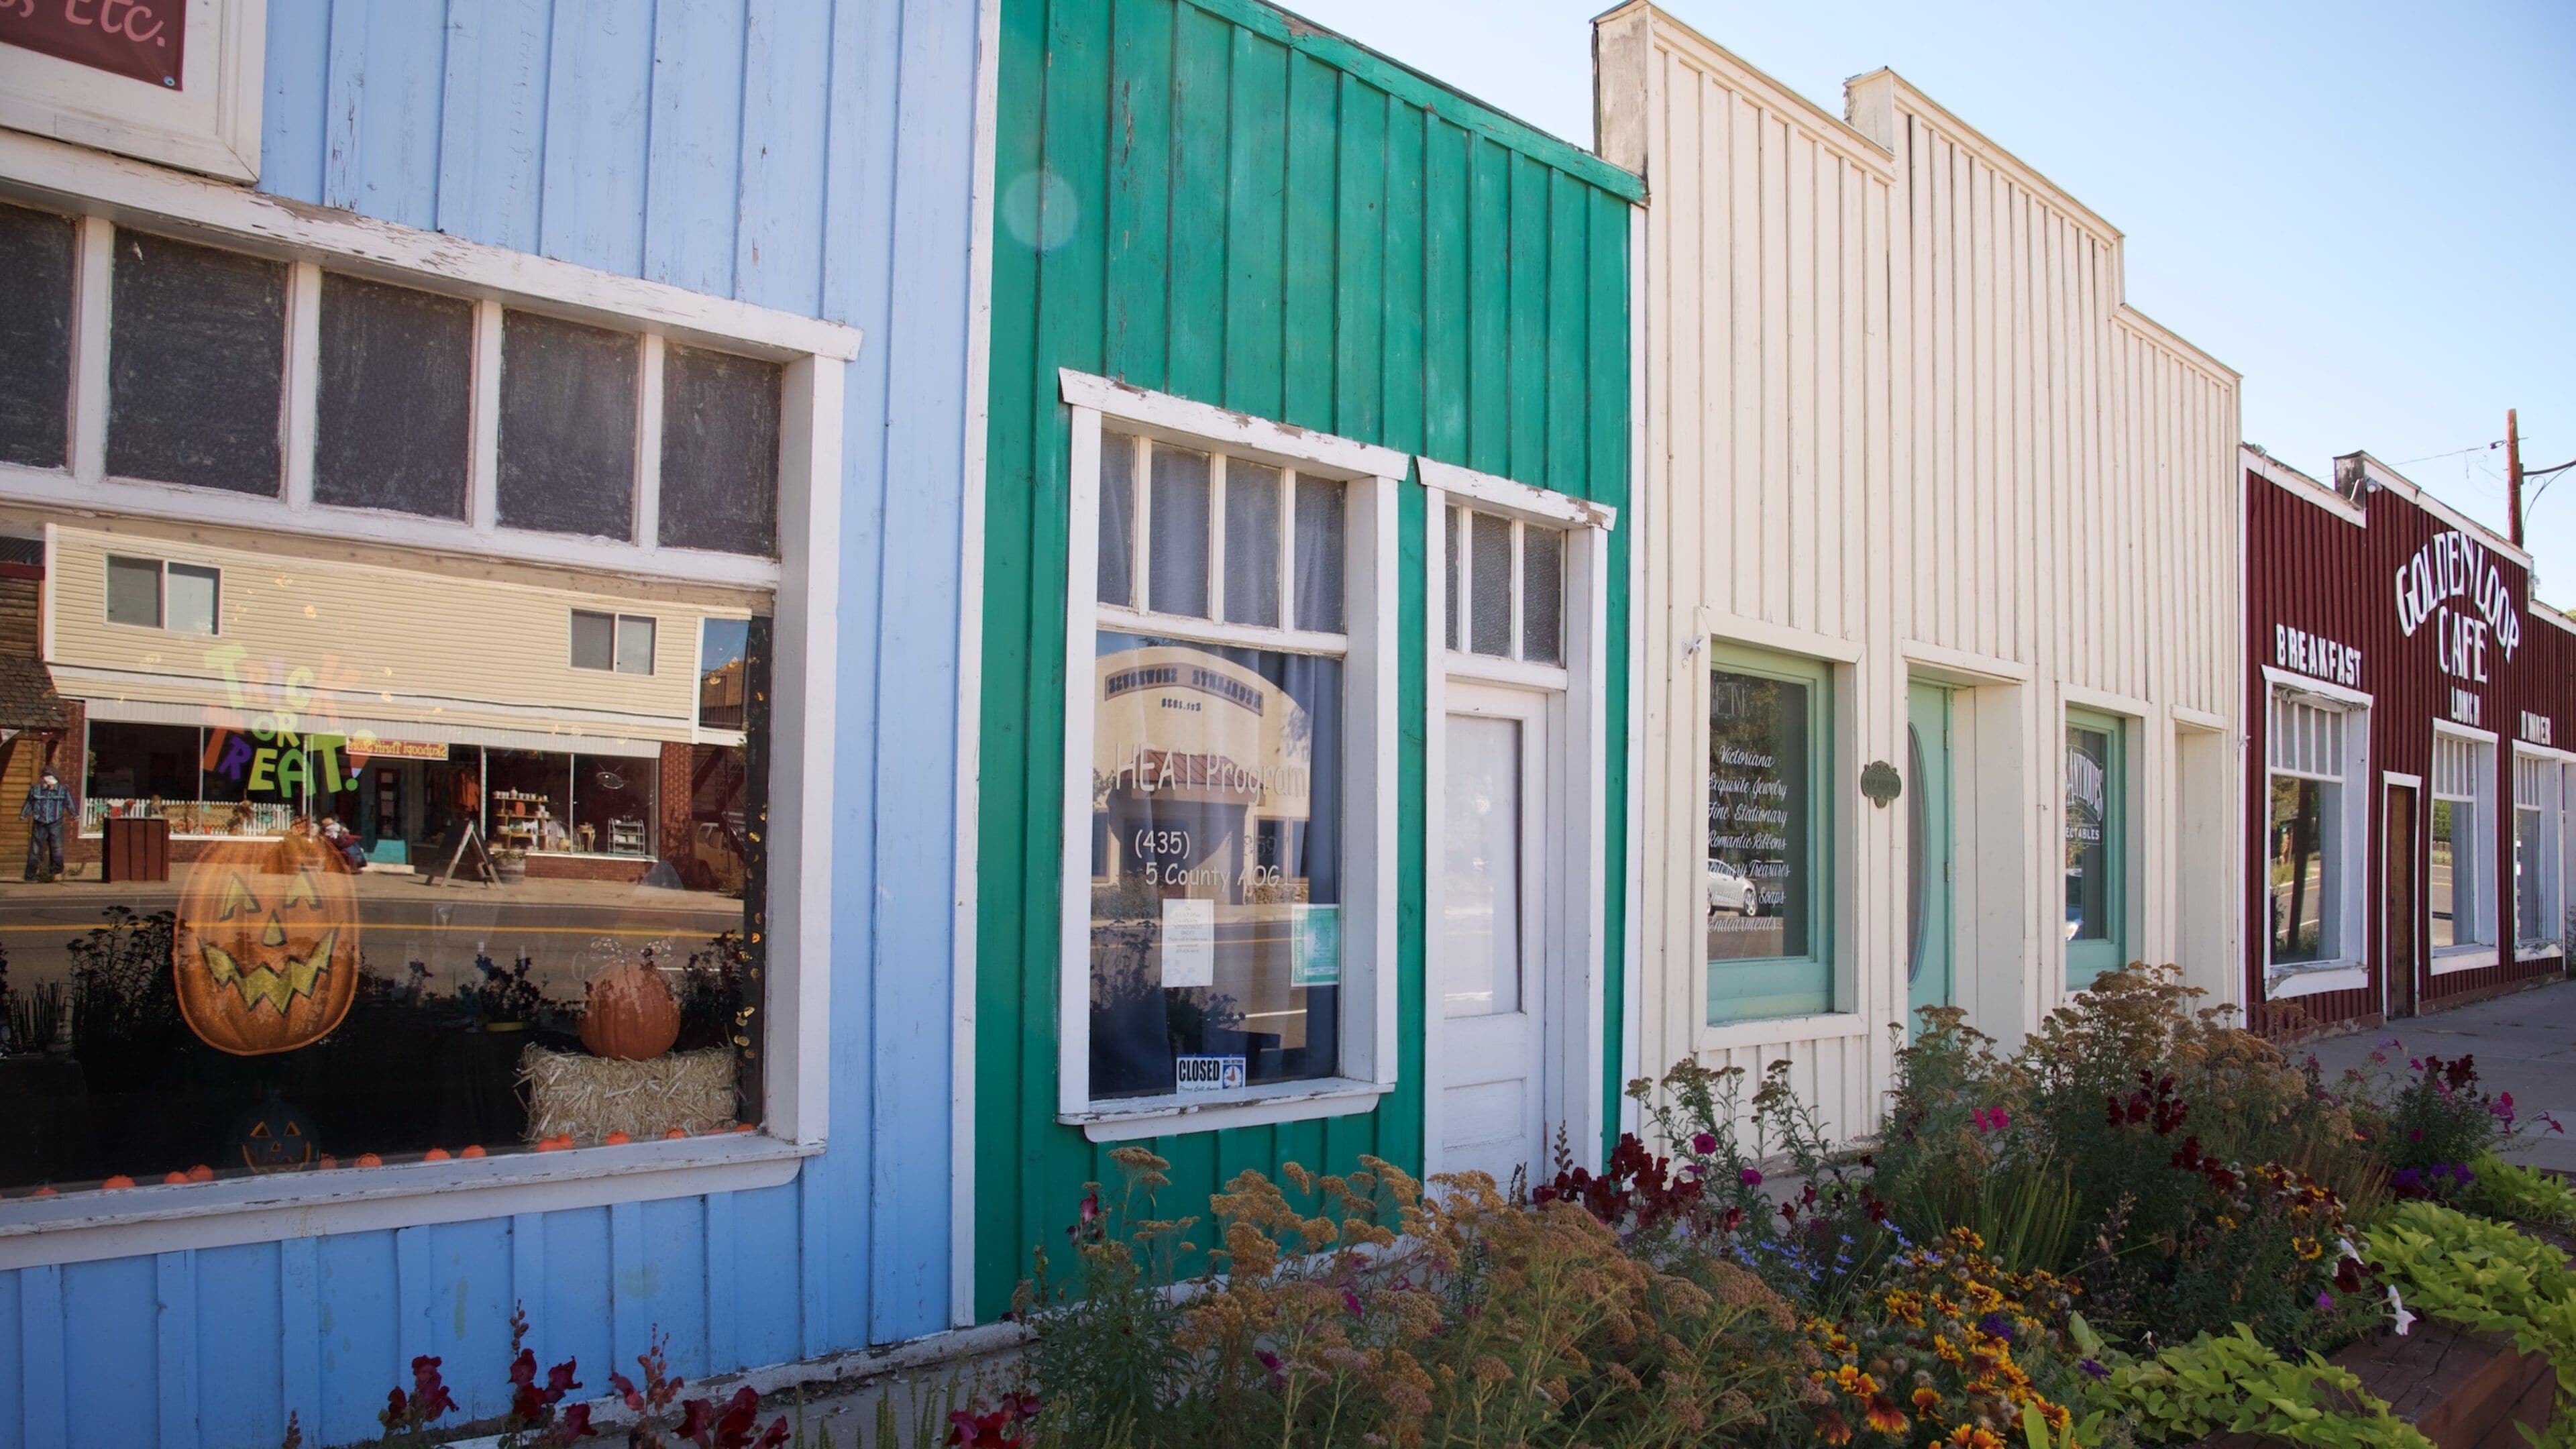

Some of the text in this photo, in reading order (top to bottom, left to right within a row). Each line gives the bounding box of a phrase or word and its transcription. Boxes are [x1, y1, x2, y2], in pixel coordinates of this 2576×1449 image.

[2395, 531, 2520, 663] GOLDEN LOOP
[2275, 623, 2361, 688] BREAKFAST
[2438, 605, 2488, 684] CAFE
[203, 642, 361, 727] TRICK
[2451, 686, 2480, 727] LUNCH
[251, 708, 301, 748] OR
[2521, 710, 2551, 745] DINNER
[203, 705, 376, 798] TREAT!
[1719, 745, 1775, 769] Victoriana
[1116, 742, 1308, 808] HEAT Program
[1709, 772, 1788, 801] Exquisite Jewelry
[1734, 803, 1788, 829] Stationary
[1135, 829, 1190, 859] (435)
[1709, 830, 1788, 850] Romantic Ribbons
[1145, 861, 1158, 885] 5
[1165, 863, 1232, 892] County
[1758, 886, 1786, 908] Soaps
[1179, 1059, 1220, 1082] CLOSED
